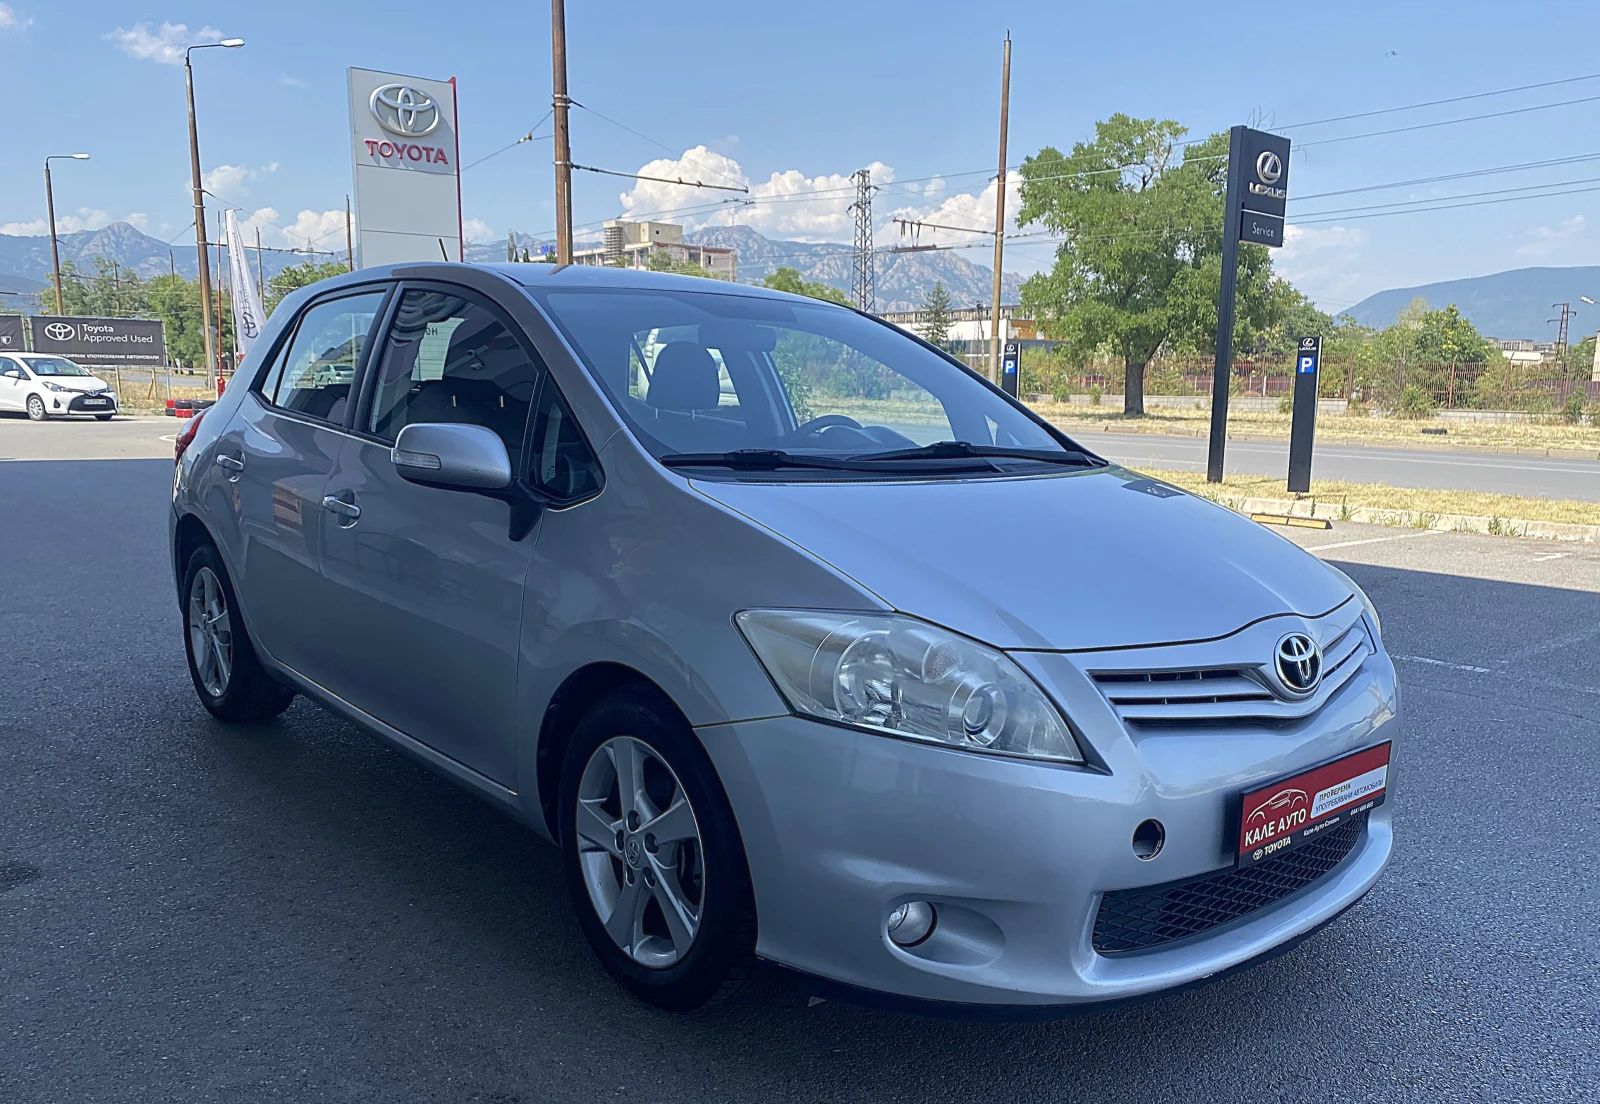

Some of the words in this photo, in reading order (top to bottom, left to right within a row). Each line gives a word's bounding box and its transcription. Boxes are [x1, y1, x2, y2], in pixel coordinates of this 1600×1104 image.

[363, 138, 449, 165] TOYOTA
[1249, 181, 1286, 199] LEXUS
[1252, 221, 1275, 238] Service
[82, 323, 114, 334] Toyota
[83, 333, 128, 344] Approved
[130, 334, 153, 343] Used
[1005, 360, 1014, 374] P
[1301, 357, 1313, 373] P
[1319, 782, 1352, 802] ПРОВЕРЕНИ
[1245, 820, 1276, 847] КАЛЕ
[1277, 808, 1307, 833] АУТО
[1264, 836, 1291, 856] TOYOTA
